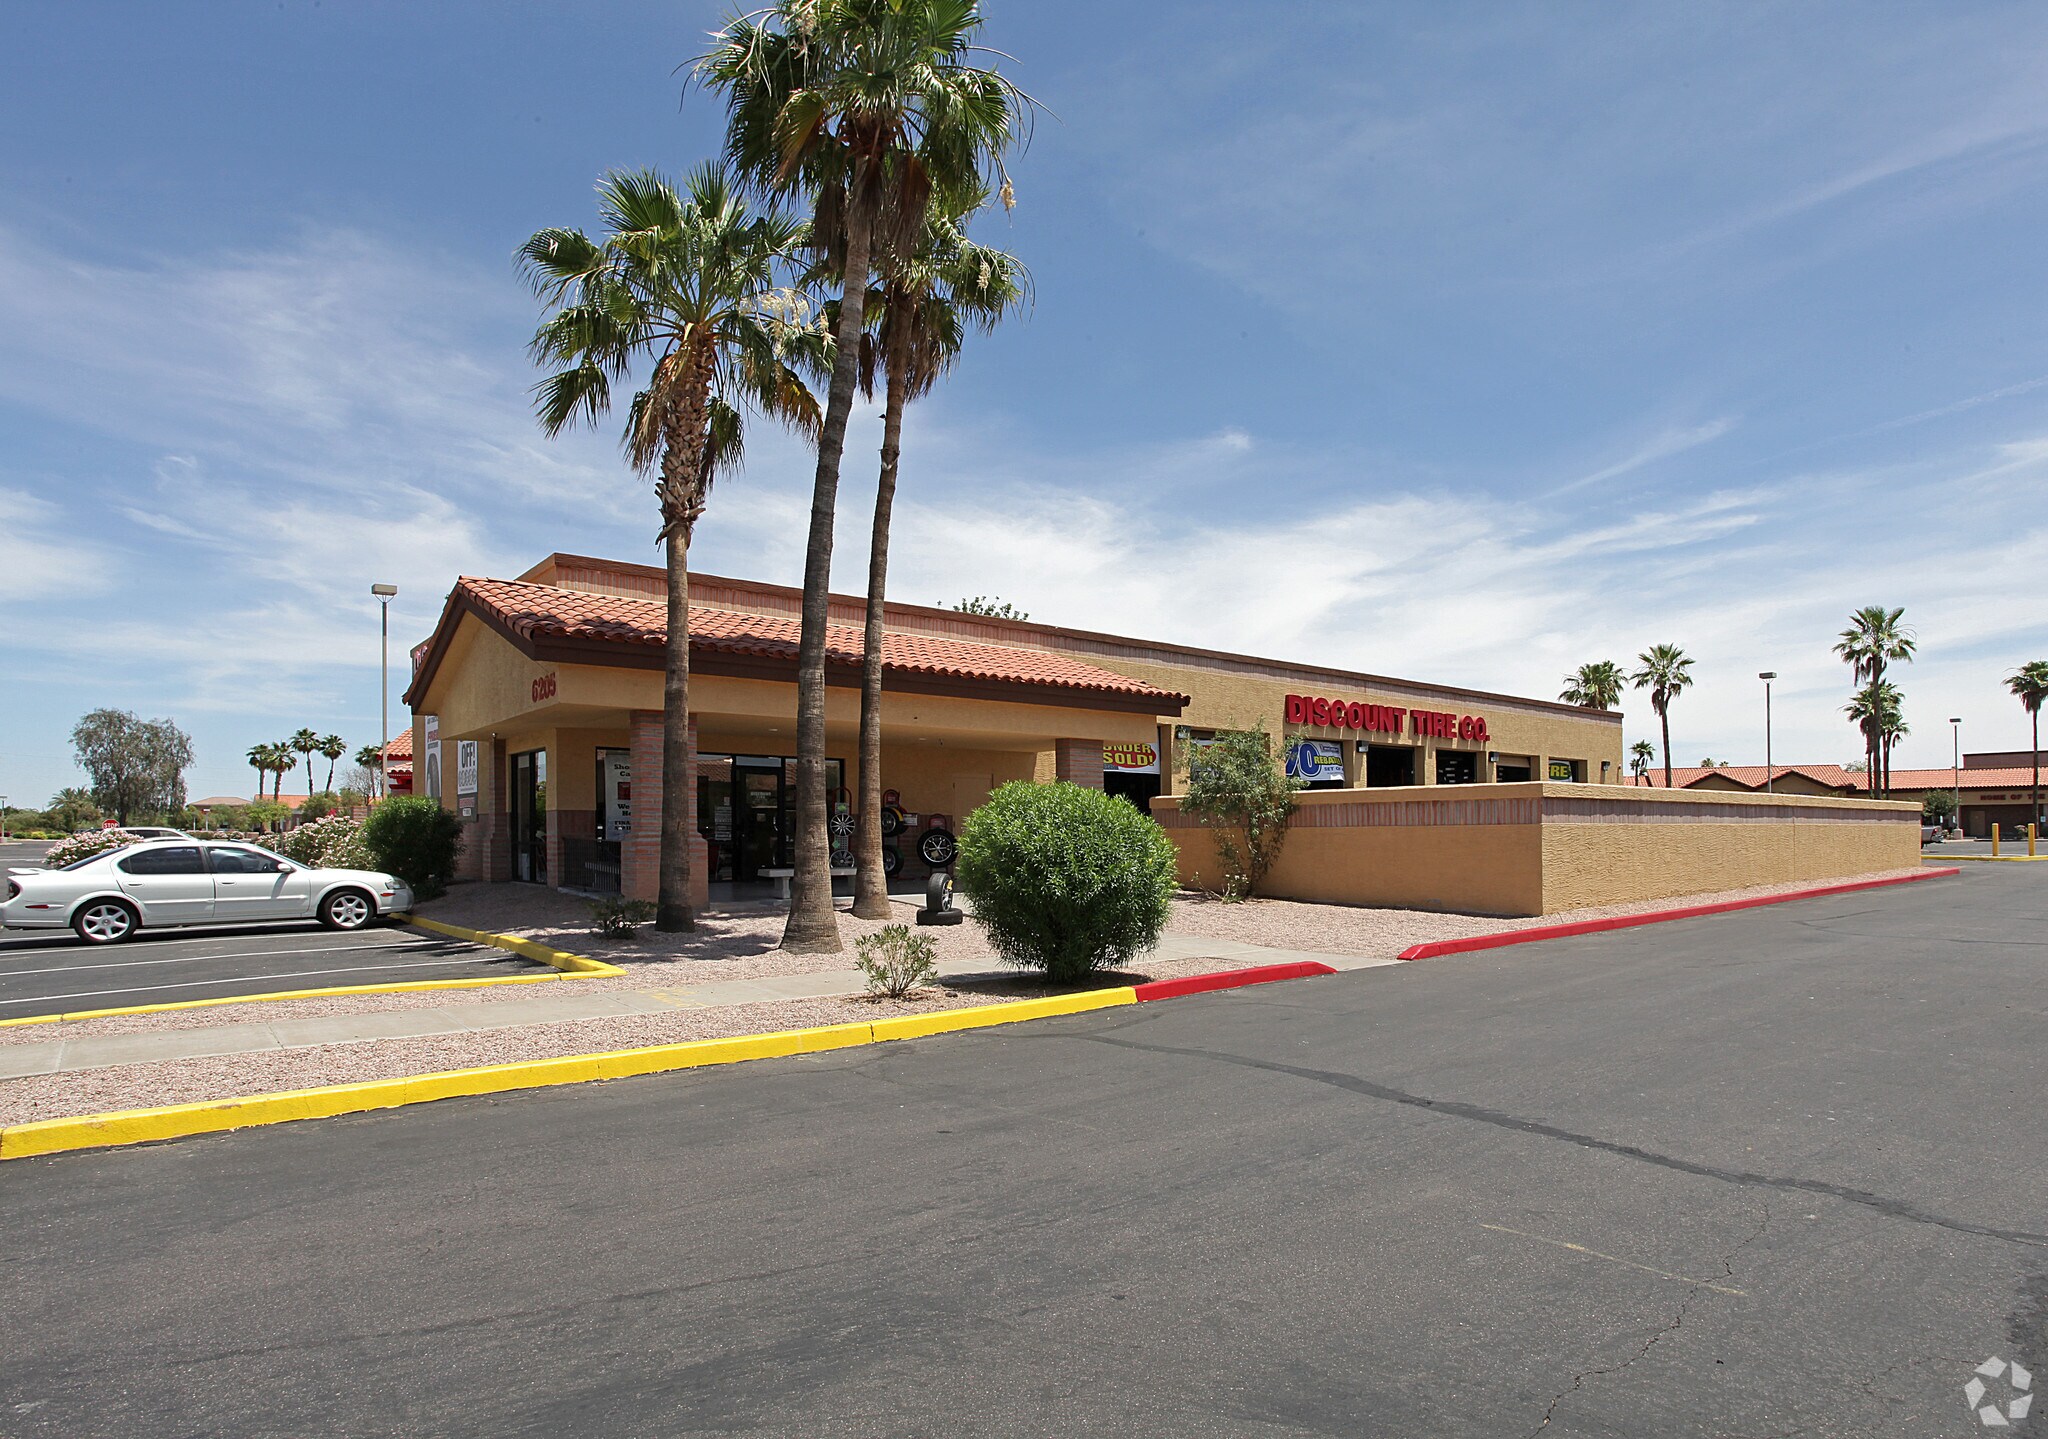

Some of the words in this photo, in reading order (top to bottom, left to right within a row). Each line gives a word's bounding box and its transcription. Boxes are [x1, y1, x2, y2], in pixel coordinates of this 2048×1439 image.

[532, 672, 556, 703] 6205
[1285, 694, 1407, 733] DISCOUNT
[1410, 709, 1457, 739] TIRE
[1459, 715, 1490, 742] CO.
[1103, 752, 1154, 767] SOLD!
